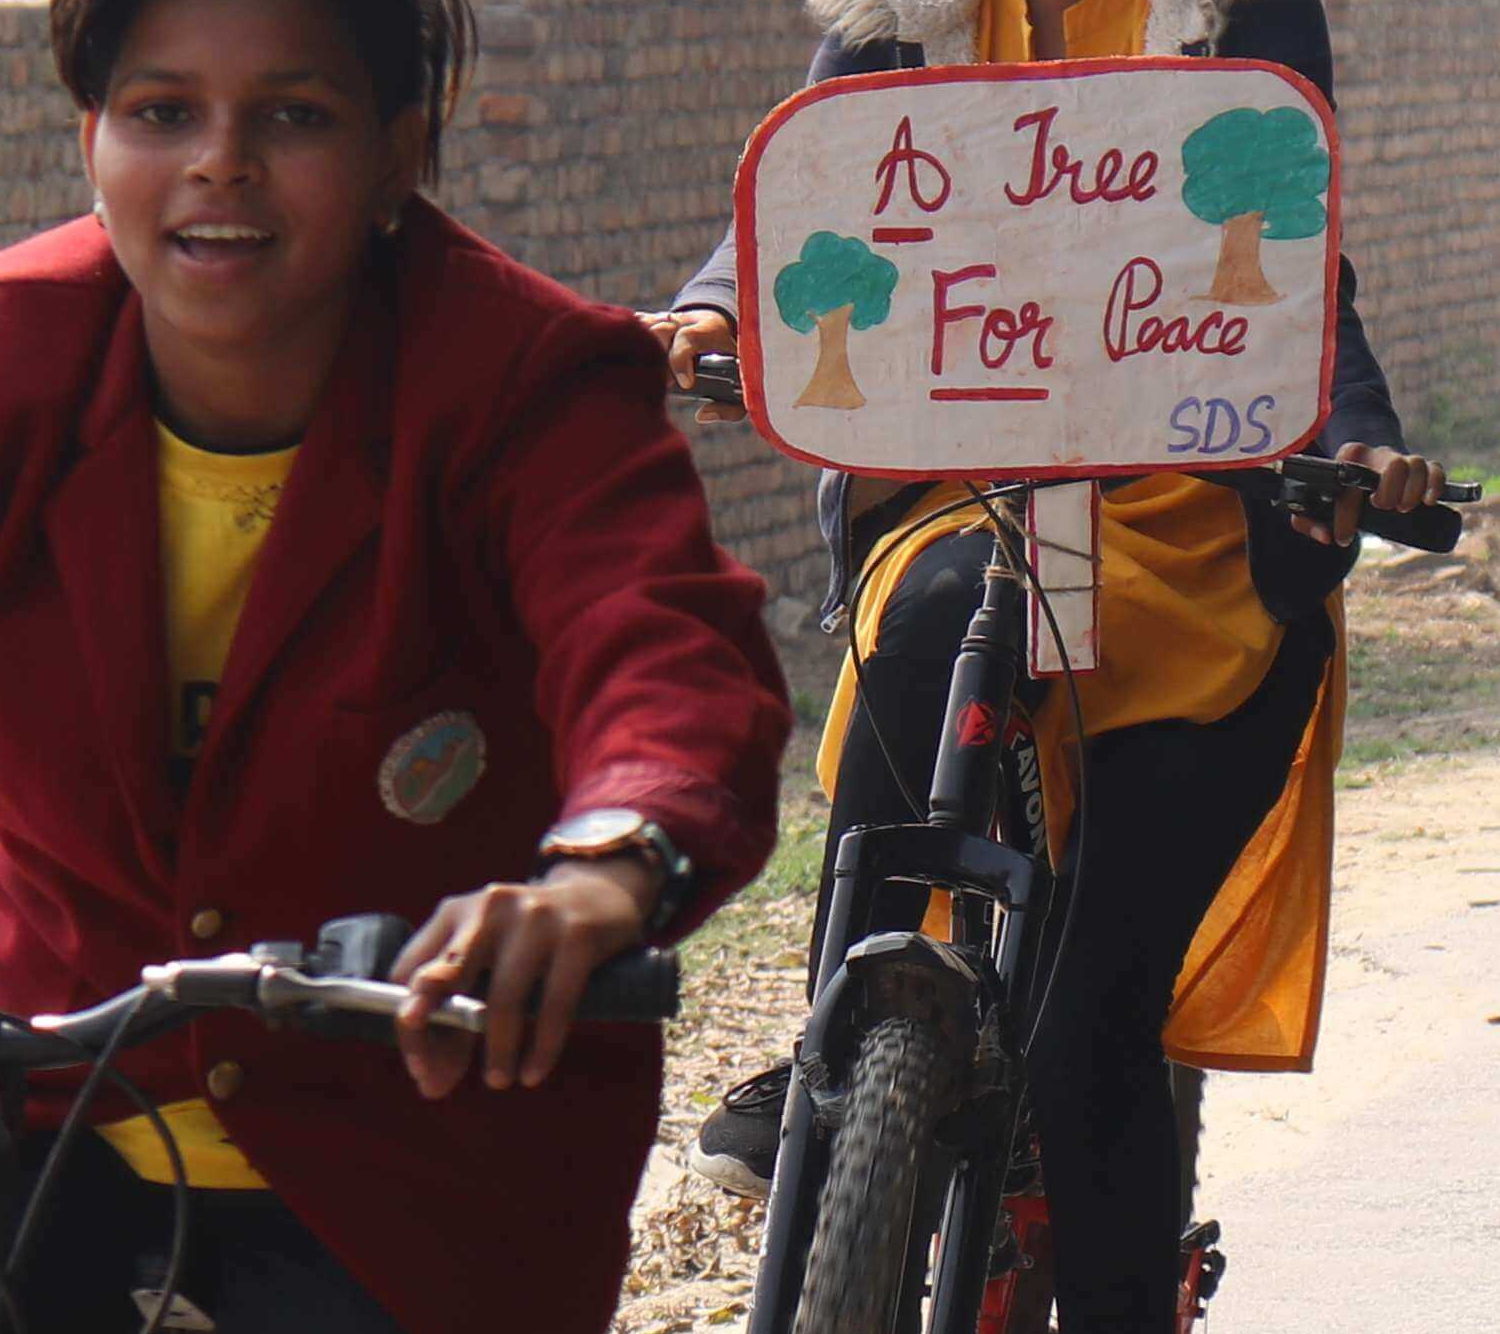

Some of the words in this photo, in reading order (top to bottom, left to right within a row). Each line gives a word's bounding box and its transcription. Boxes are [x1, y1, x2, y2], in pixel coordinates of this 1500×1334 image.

[874, 116, 952, 217] A
[1004, 106, 1158, 206] Tree
[931, 264, 1054, 375] For
[1103, 256, 1249, 362] Peace
[1167, 395, 1276, 453] SDS
